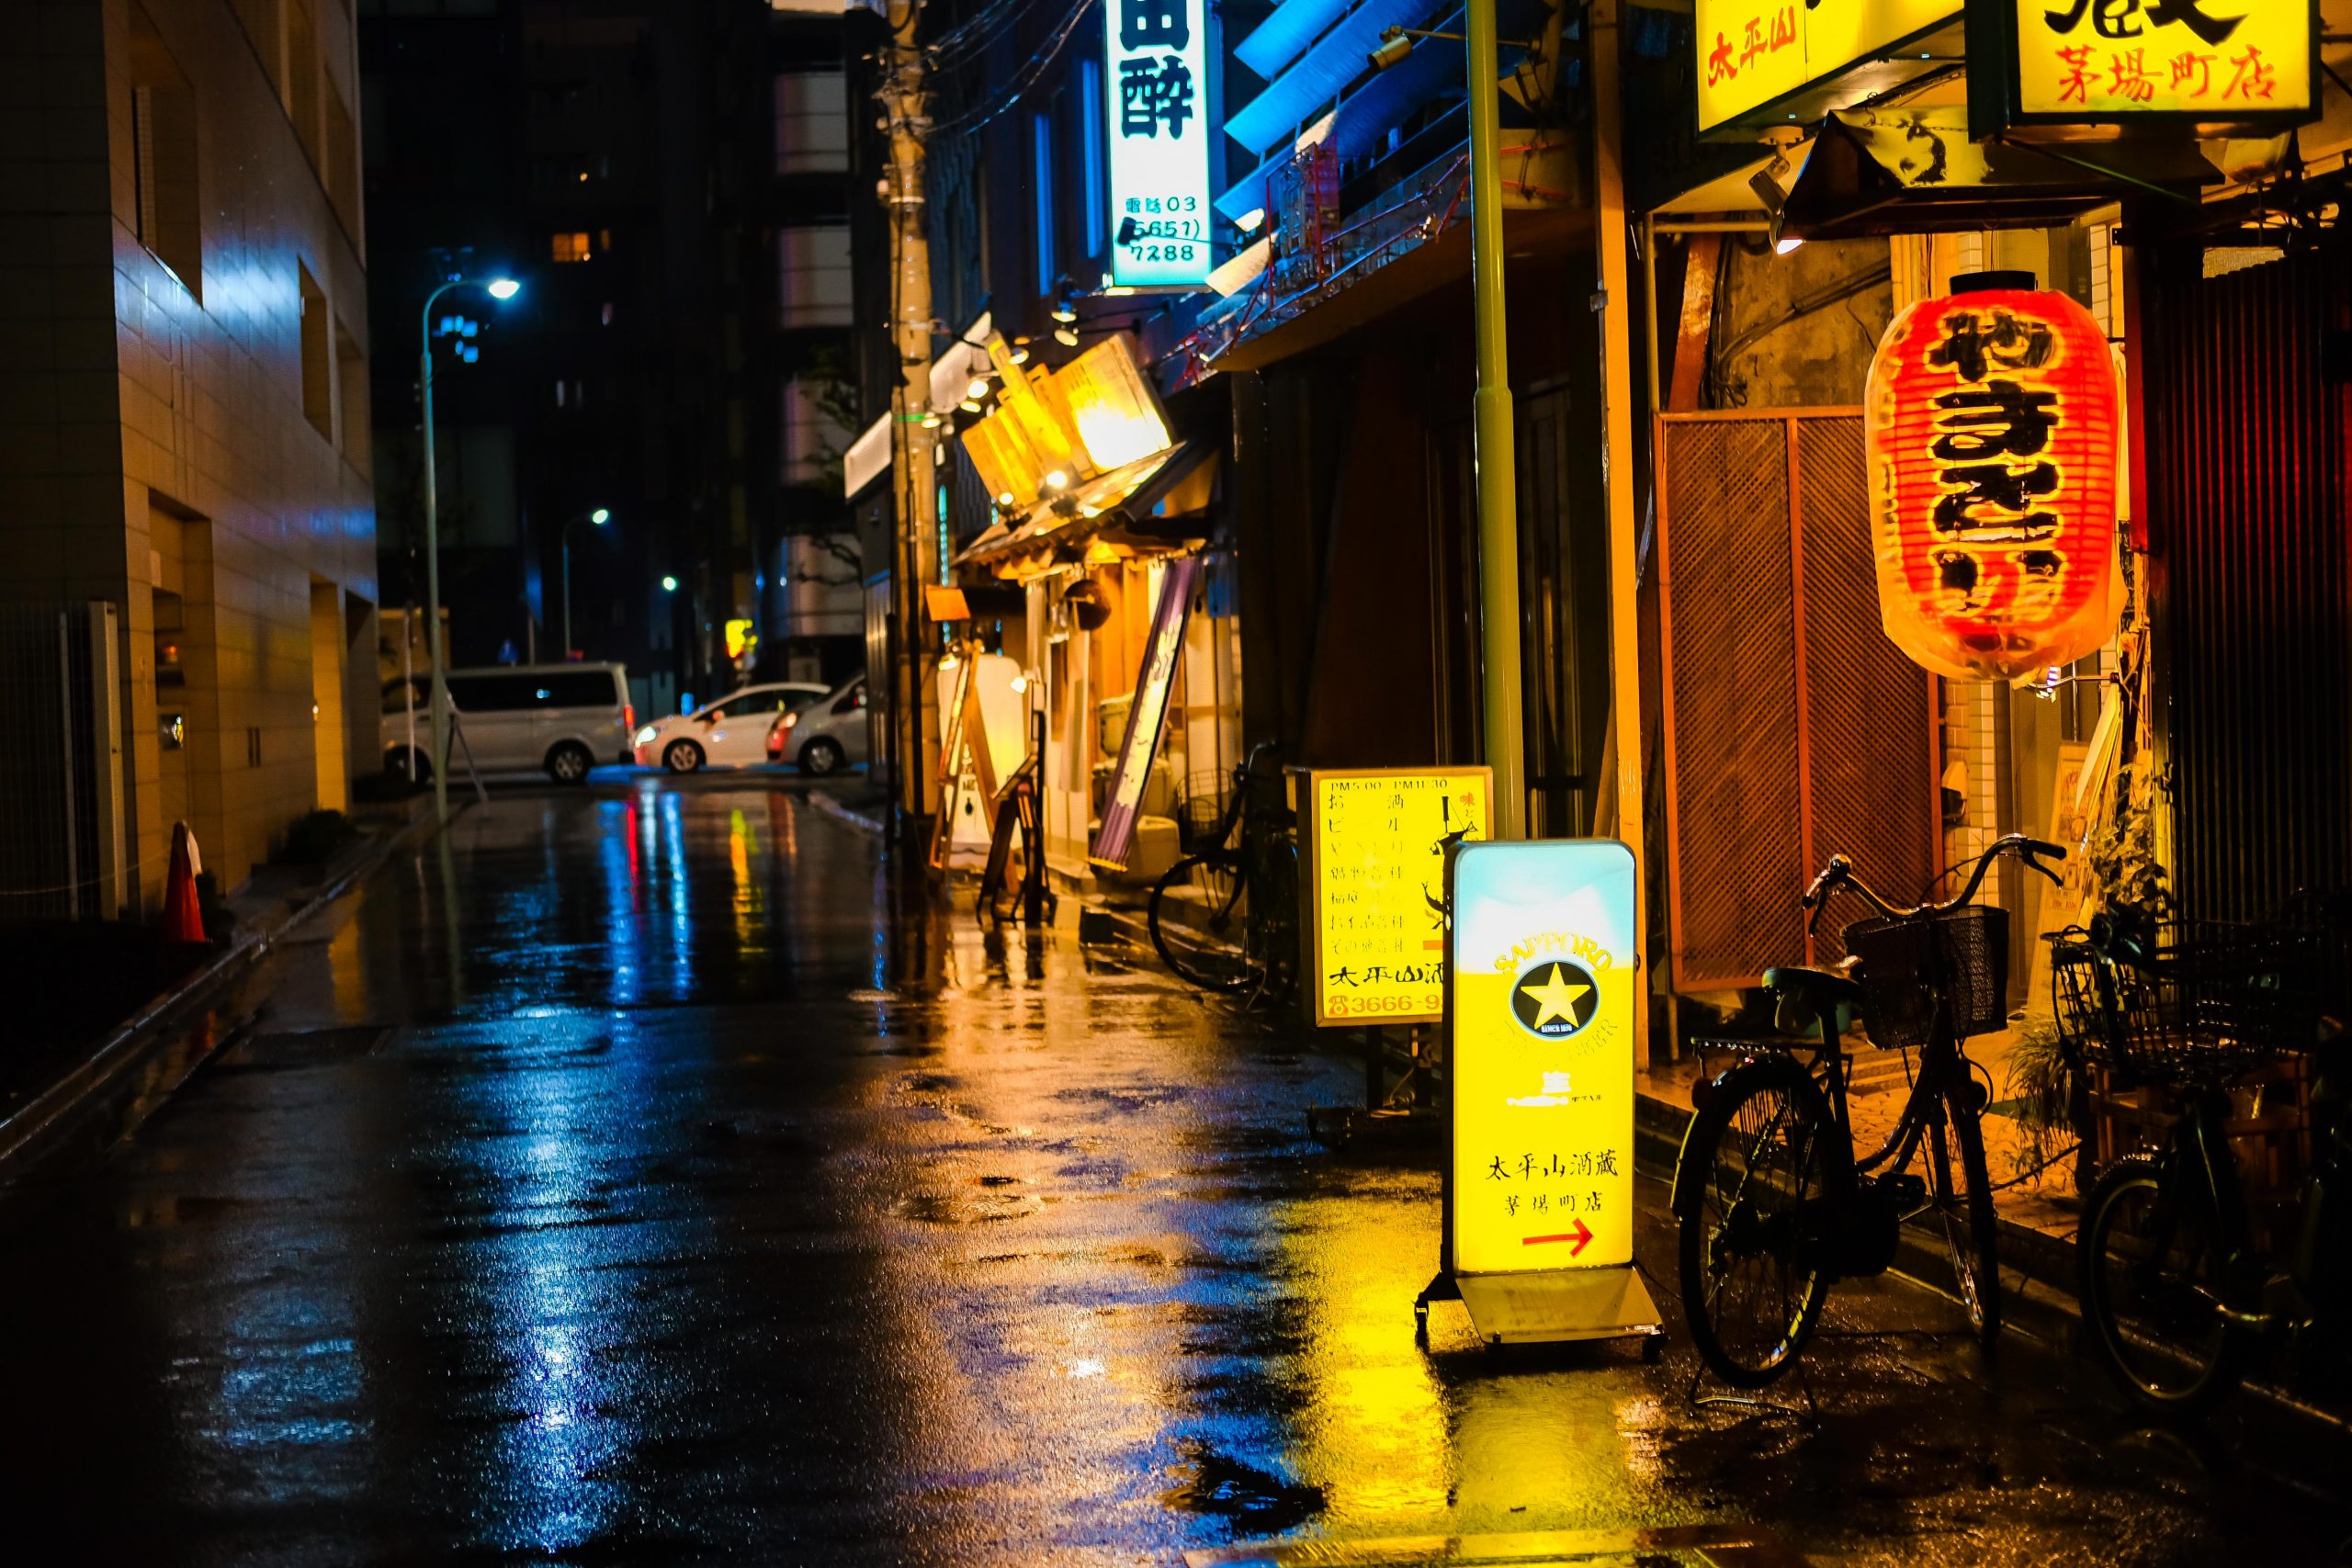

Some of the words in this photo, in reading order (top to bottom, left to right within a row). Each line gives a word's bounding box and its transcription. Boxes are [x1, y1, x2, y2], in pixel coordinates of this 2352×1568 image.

[1707, 5, 1796, 88] 太平山
[2055, 44, 2277, 103] 茅場町店
[1167, 197, 1196, 211] 03
[1131, 245, 1194, 261] 7288
[1494, 931, 1612, 976] SAPPORO
[1351, 994, 1442, 1013] 3666-9
[1486, 1149, 1619, 1181] 太平山酒蔵
